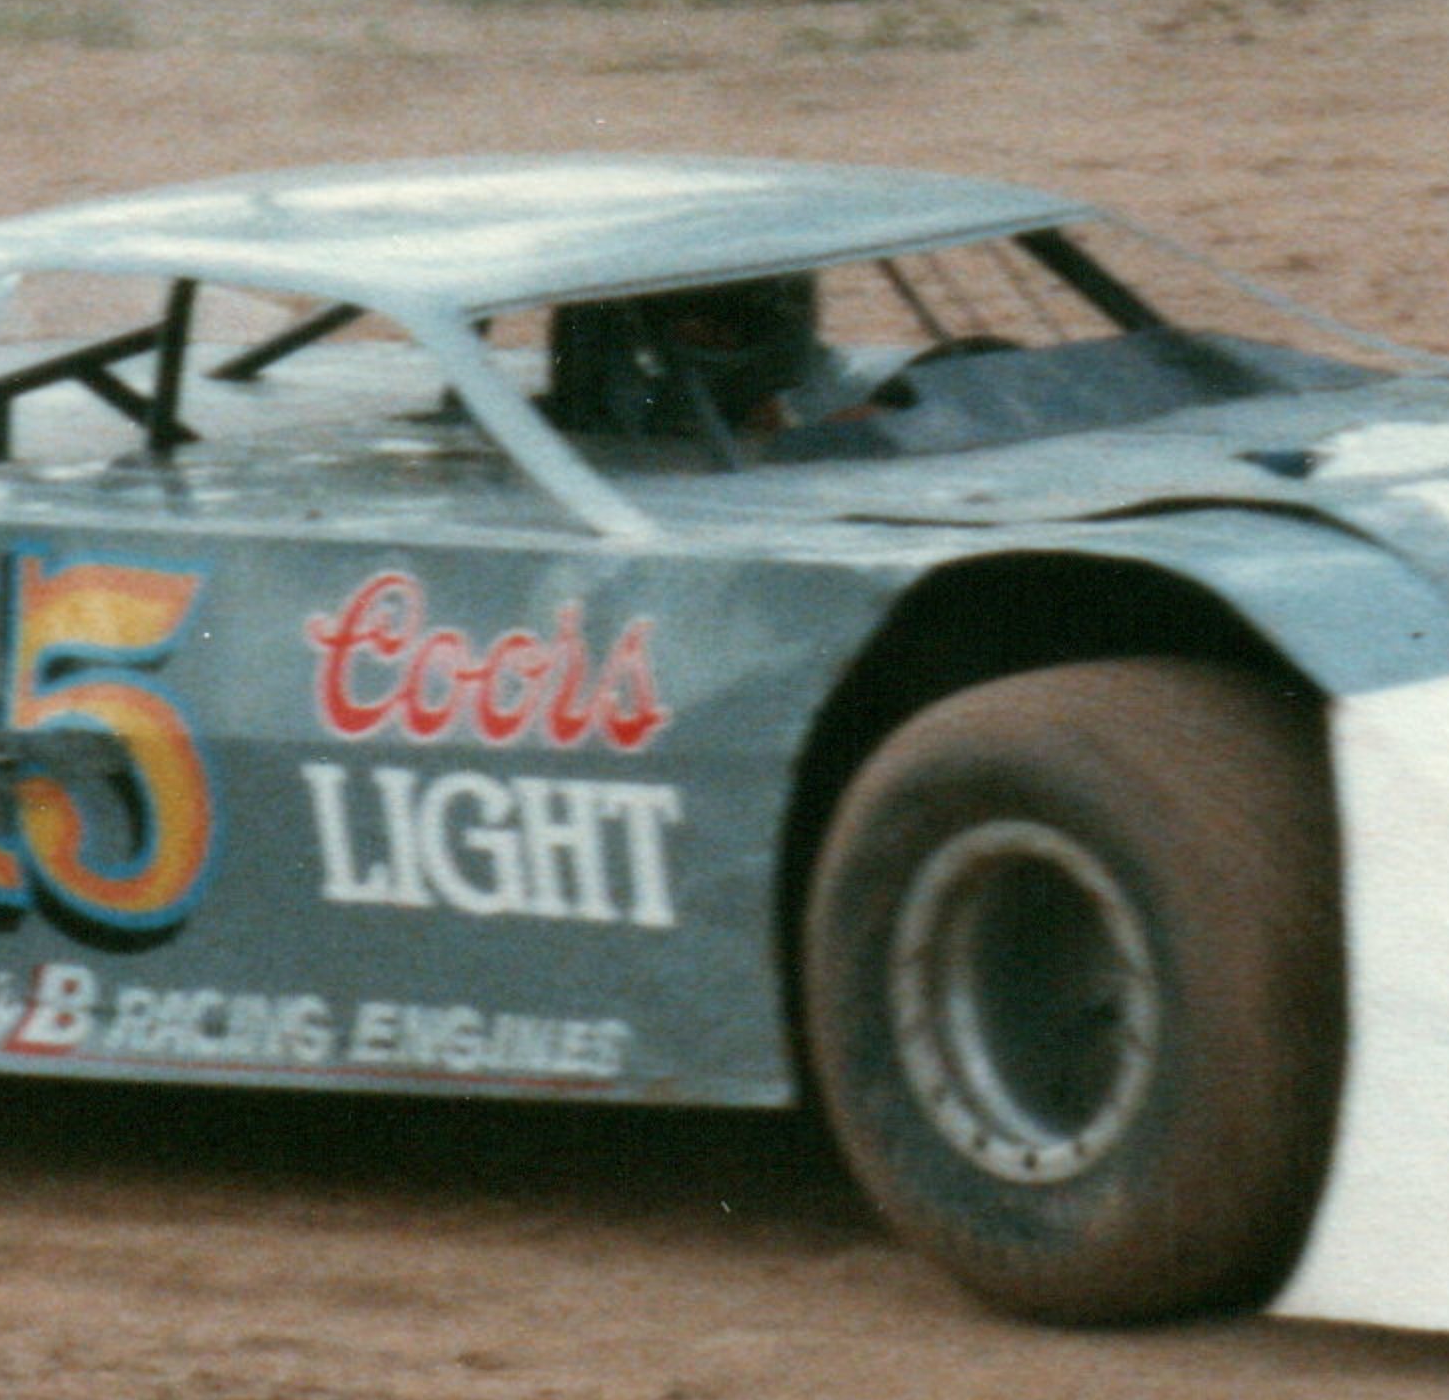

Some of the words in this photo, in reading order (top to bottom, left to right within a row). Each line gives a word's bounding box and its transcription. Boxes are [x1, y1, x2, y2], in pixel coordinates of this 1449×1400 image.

[307, 569, 669, 752] Coors
[301, 762, 685, 928] LIGHT
[101, 984, 334, 1065] RACING
[349, 999, 635, 1080] ENGINES
